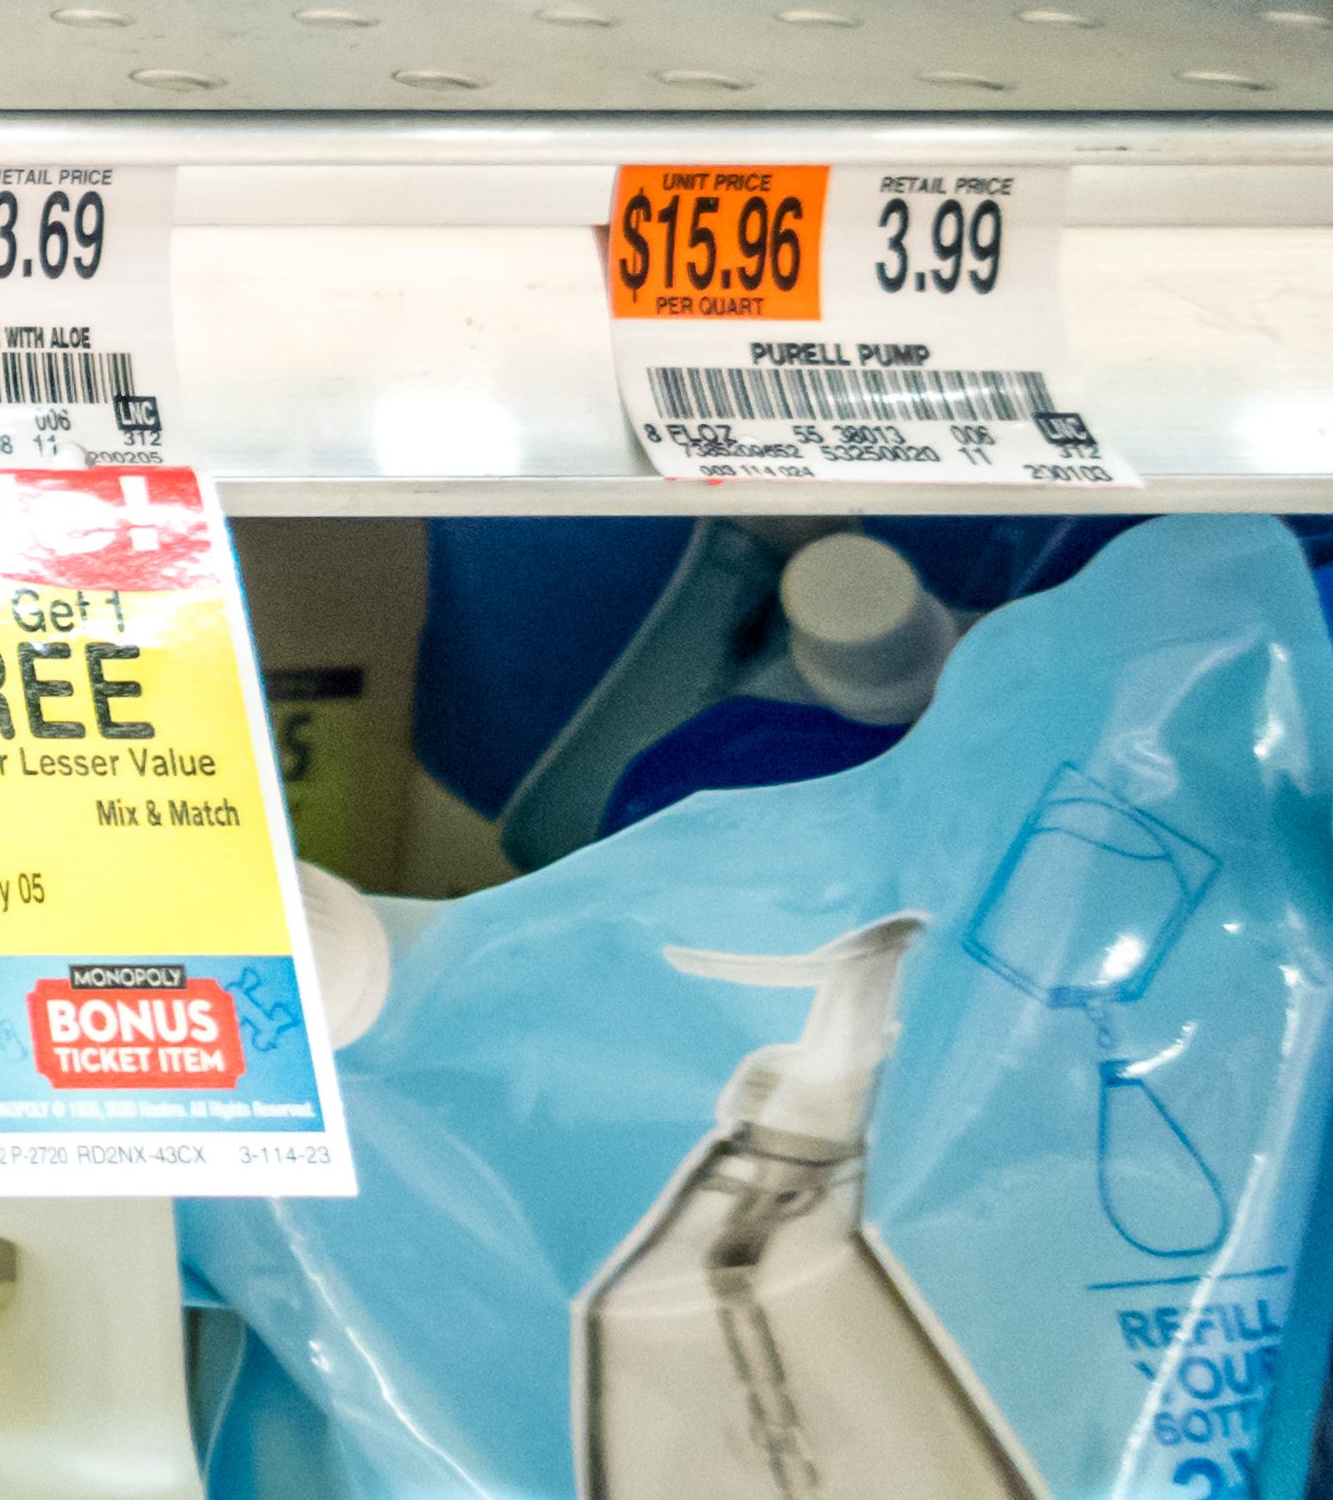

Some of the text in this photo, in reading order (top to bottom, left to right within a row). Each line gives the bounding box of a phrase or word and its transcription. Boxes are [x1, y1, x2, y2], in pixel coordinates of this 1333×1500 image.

[59, 168, 113, 186] PRICE
[662, 173, 773, 193] UNIT PRICE
[880, 176, 1015, 196] RETAIL PRICE
[618, 187, 804, 302] $15.96
[876, 197, 1003, 295] 3.99
[656, 296, 764, 316] PER QUART
[4, 326, 45, 349] WITH
[50, 326, 91, 349] ALOE
[749, 342, 932, 367] PURELL PUMP
[115, 396, 162, 431] LNC
[123, 431, 162, 447] 312
[644, 423, 662, 443] 8
[792, 425, 824, 444] 55
[832, 425, 906, 445] 38013
[950, 424, 995, 445] 006
[819, 444, 941, 462] 53250020
[958, 447, 992, 465] 11
[11, 587, 91, 633] Get
[106, 588, 126, 633] 1
[21, 747, 120, 777] Lesser
[131, 747, 216, 778] Value
[96, 799, 242, 828] Mix & Match
[17, 872, 46, 905] 05
[73, 967, 184, 988] MONOPOLY
[46, 998, 219, 1044] BONUS
[53, 1047, 226, 1074] TICKET ITEM
[11, 1146, 69, 1166] P-2720
[76, 1145, 208, 1165] RD2NX-43CX
[239, 1145, 332, 1165] 3-114-23
